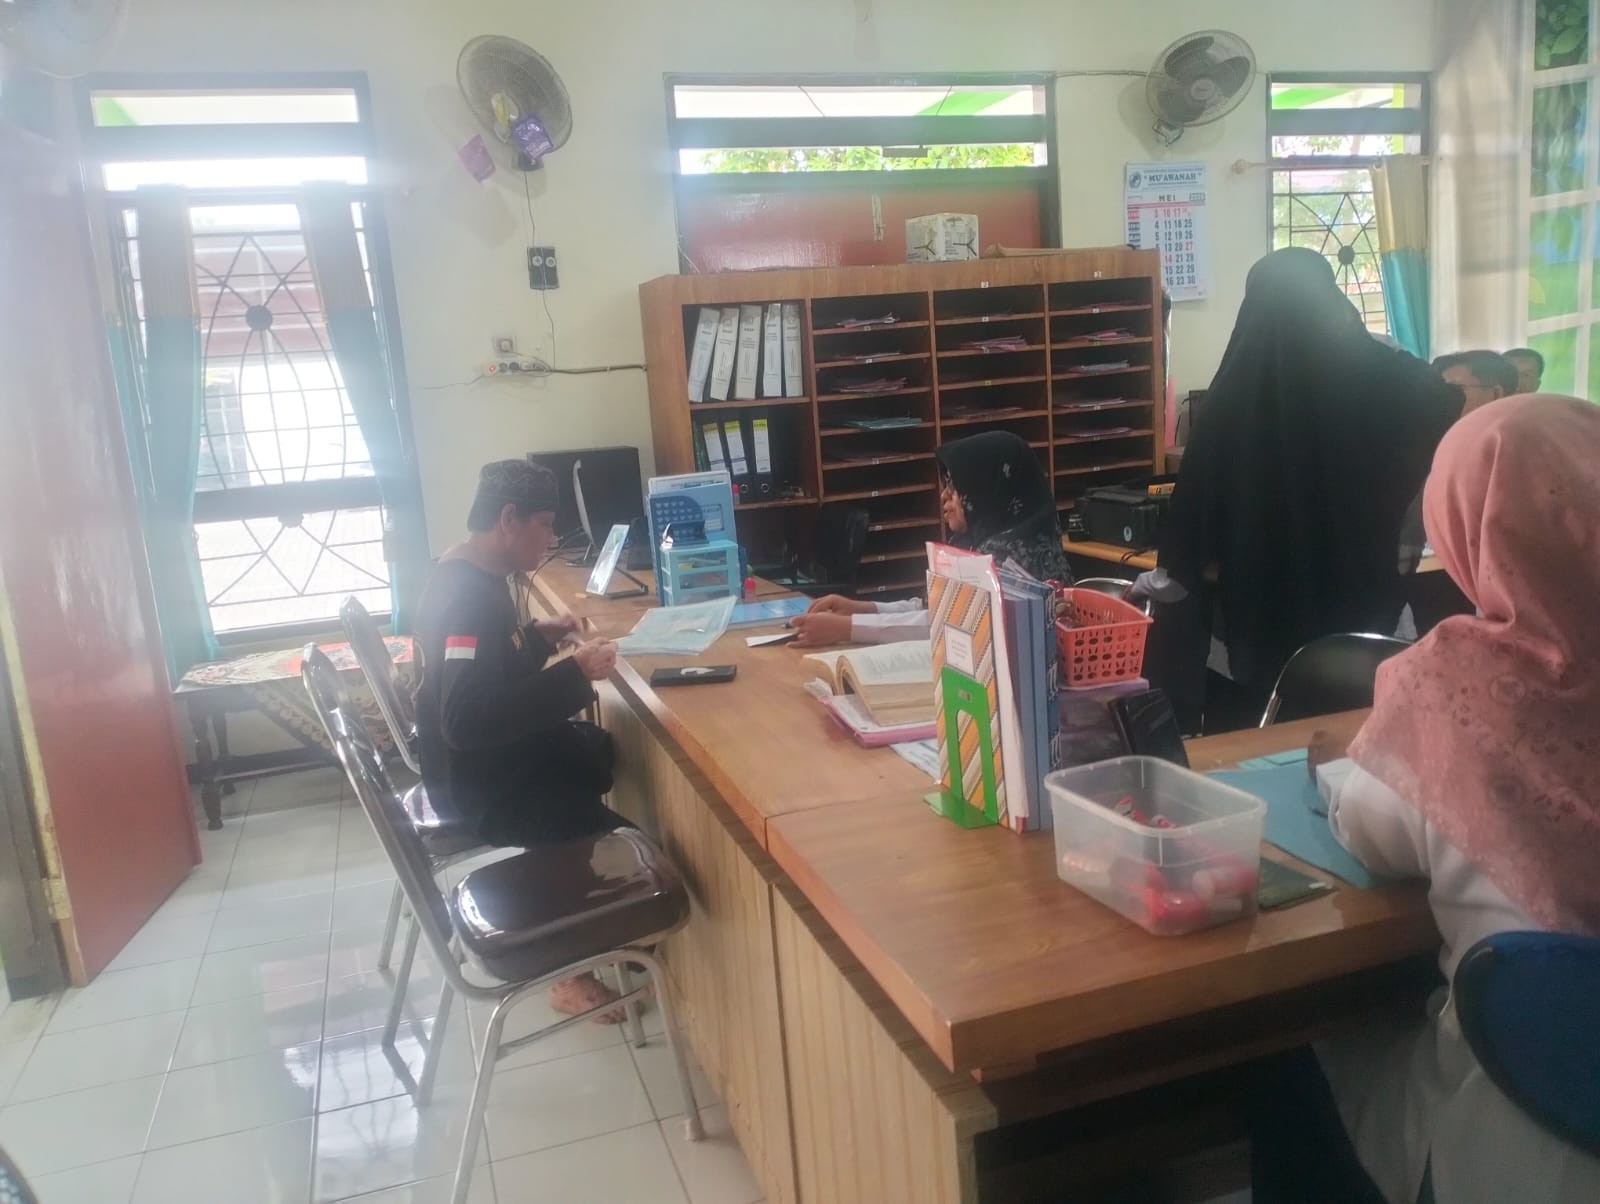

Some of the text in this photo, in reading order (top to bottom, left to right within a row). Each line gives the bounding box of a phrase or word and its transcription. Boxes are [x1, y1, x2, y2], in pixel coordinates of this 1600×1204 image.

[1184, 218, 1193, 228] 25
[1155, 230, 1193, 241] 5 12 19 26
[1165, 243, 1173, 252] 13
[1174, 242, 1183, 252] 20
[1185, 241, 1193, 251] 27
[1165, 253, 1194, 264] 14 21 28
[1165, 264, 1195, 275] 15 22 29
[1166, 275, 1196, 286] 16 23 30
